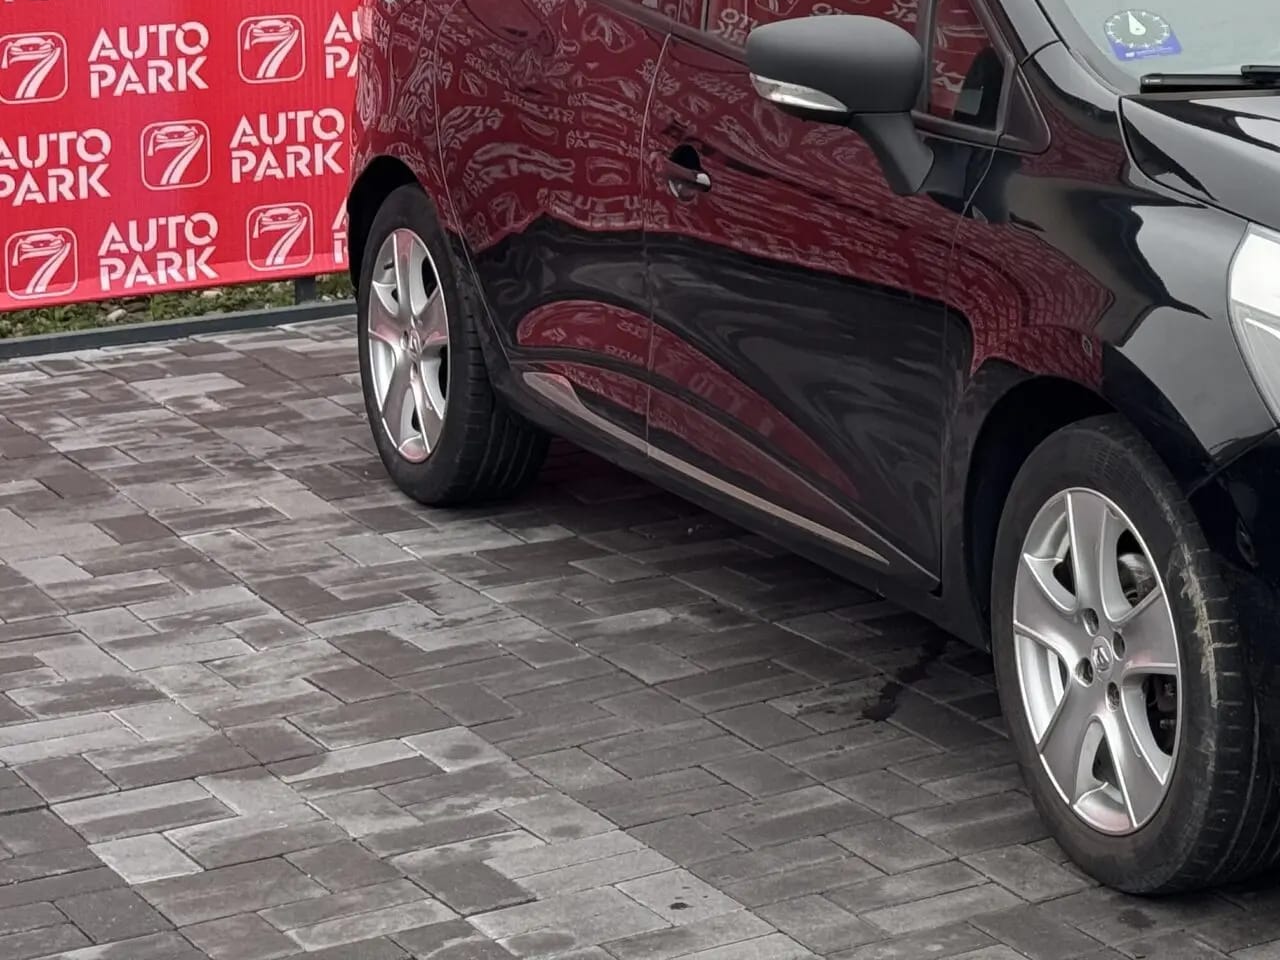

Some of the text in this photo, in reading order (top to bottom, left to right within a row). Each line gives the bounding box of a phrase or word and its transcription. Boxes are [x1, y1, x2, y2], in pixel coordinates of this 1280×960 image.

[87, 21, 210, 63] AUTO
[89, 55, 209, 99] PARK
[229, 107, 345, 149] AUTO
[231, 141, 345, 184] PARK
[97, 212, 219, 257] AUTO
[99, 246, 220, 292] PARK
